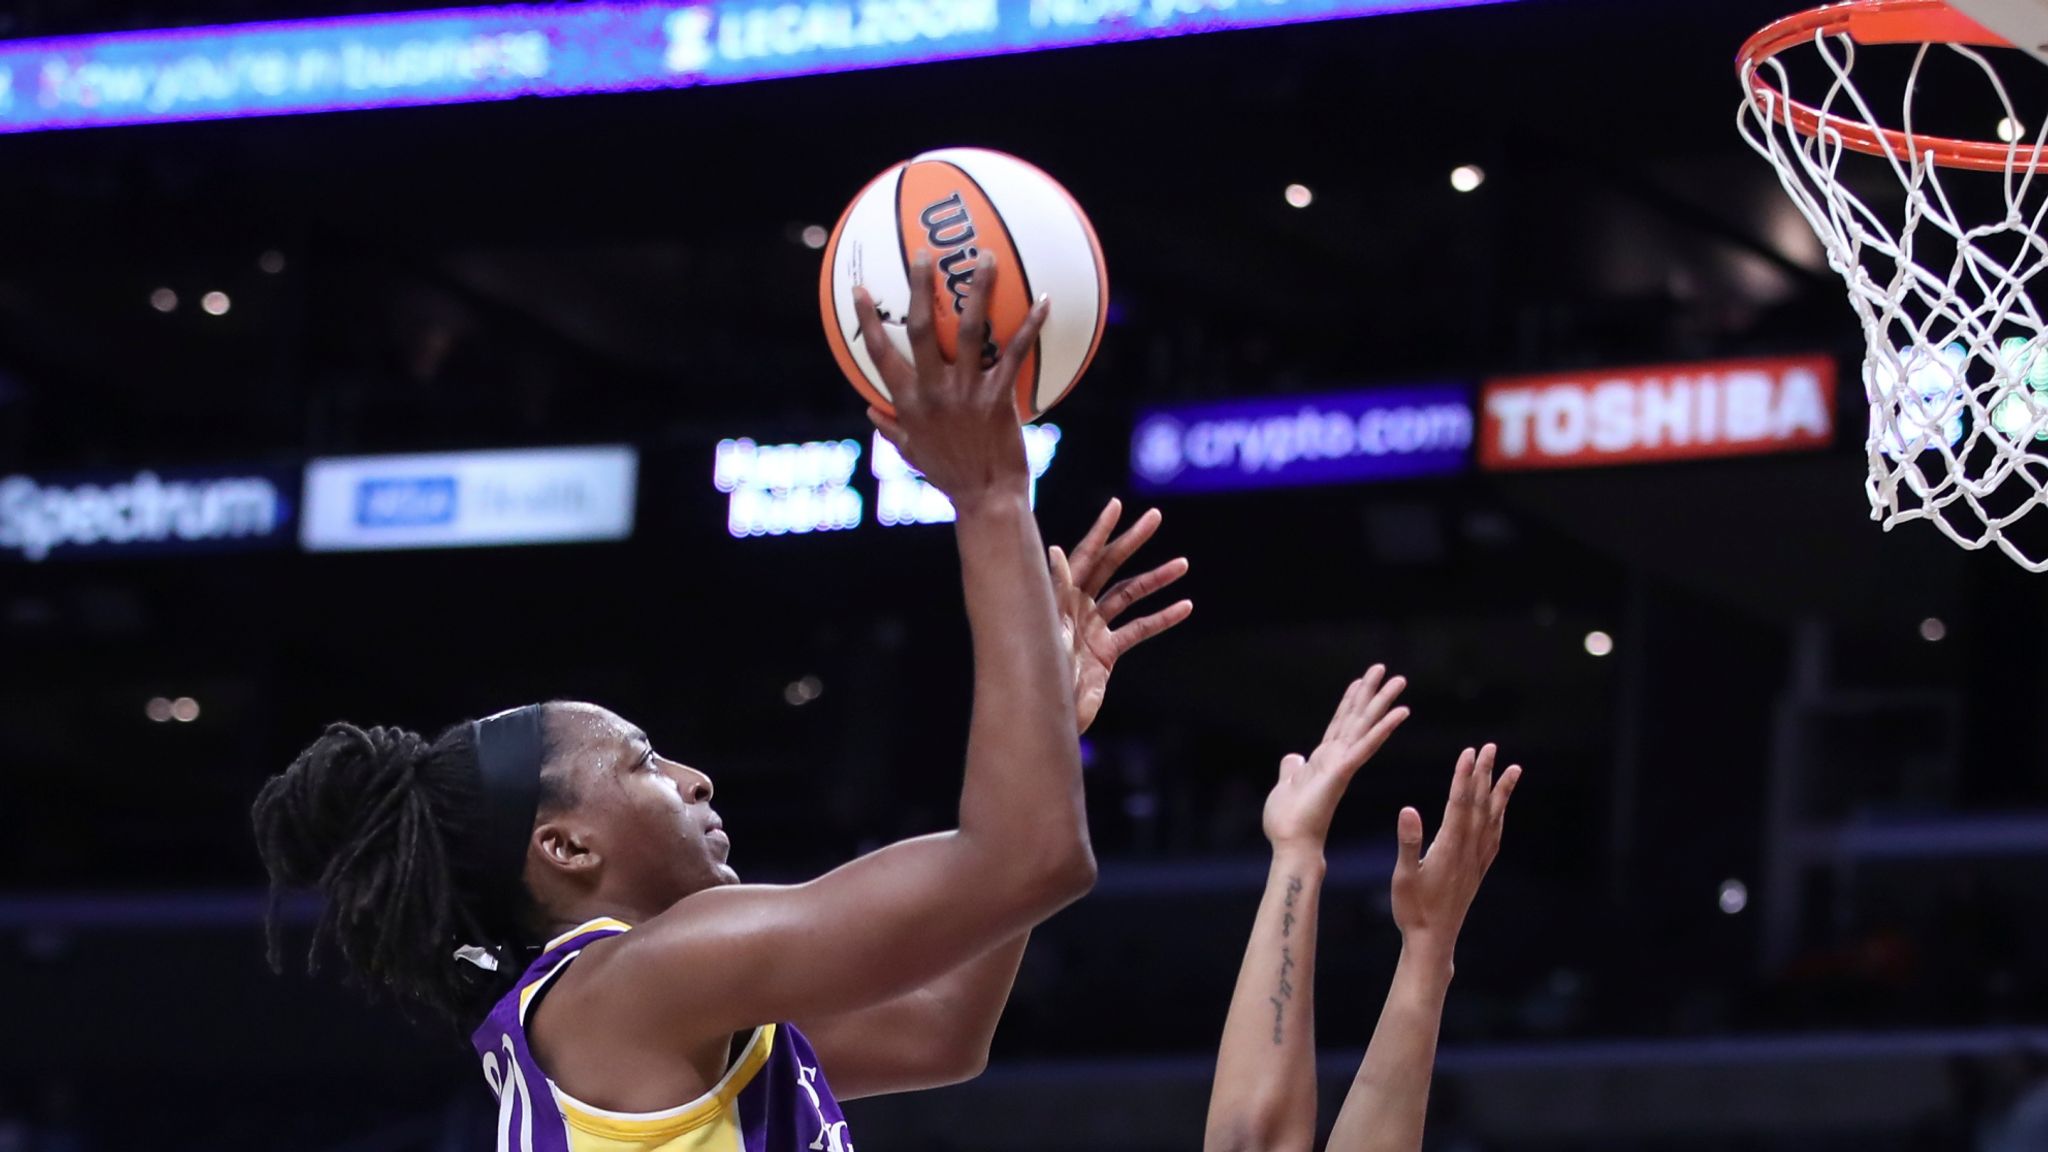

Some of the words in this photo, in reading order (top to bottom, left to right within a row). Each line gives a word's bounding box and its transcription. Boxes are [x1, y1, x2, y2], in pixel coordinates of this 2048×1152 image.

[1185, 403, 1472, 472] crypto.com
[1488, 368, 1829, 457] TOSHIBA
[0, 470, 277, 560] Spectrum
